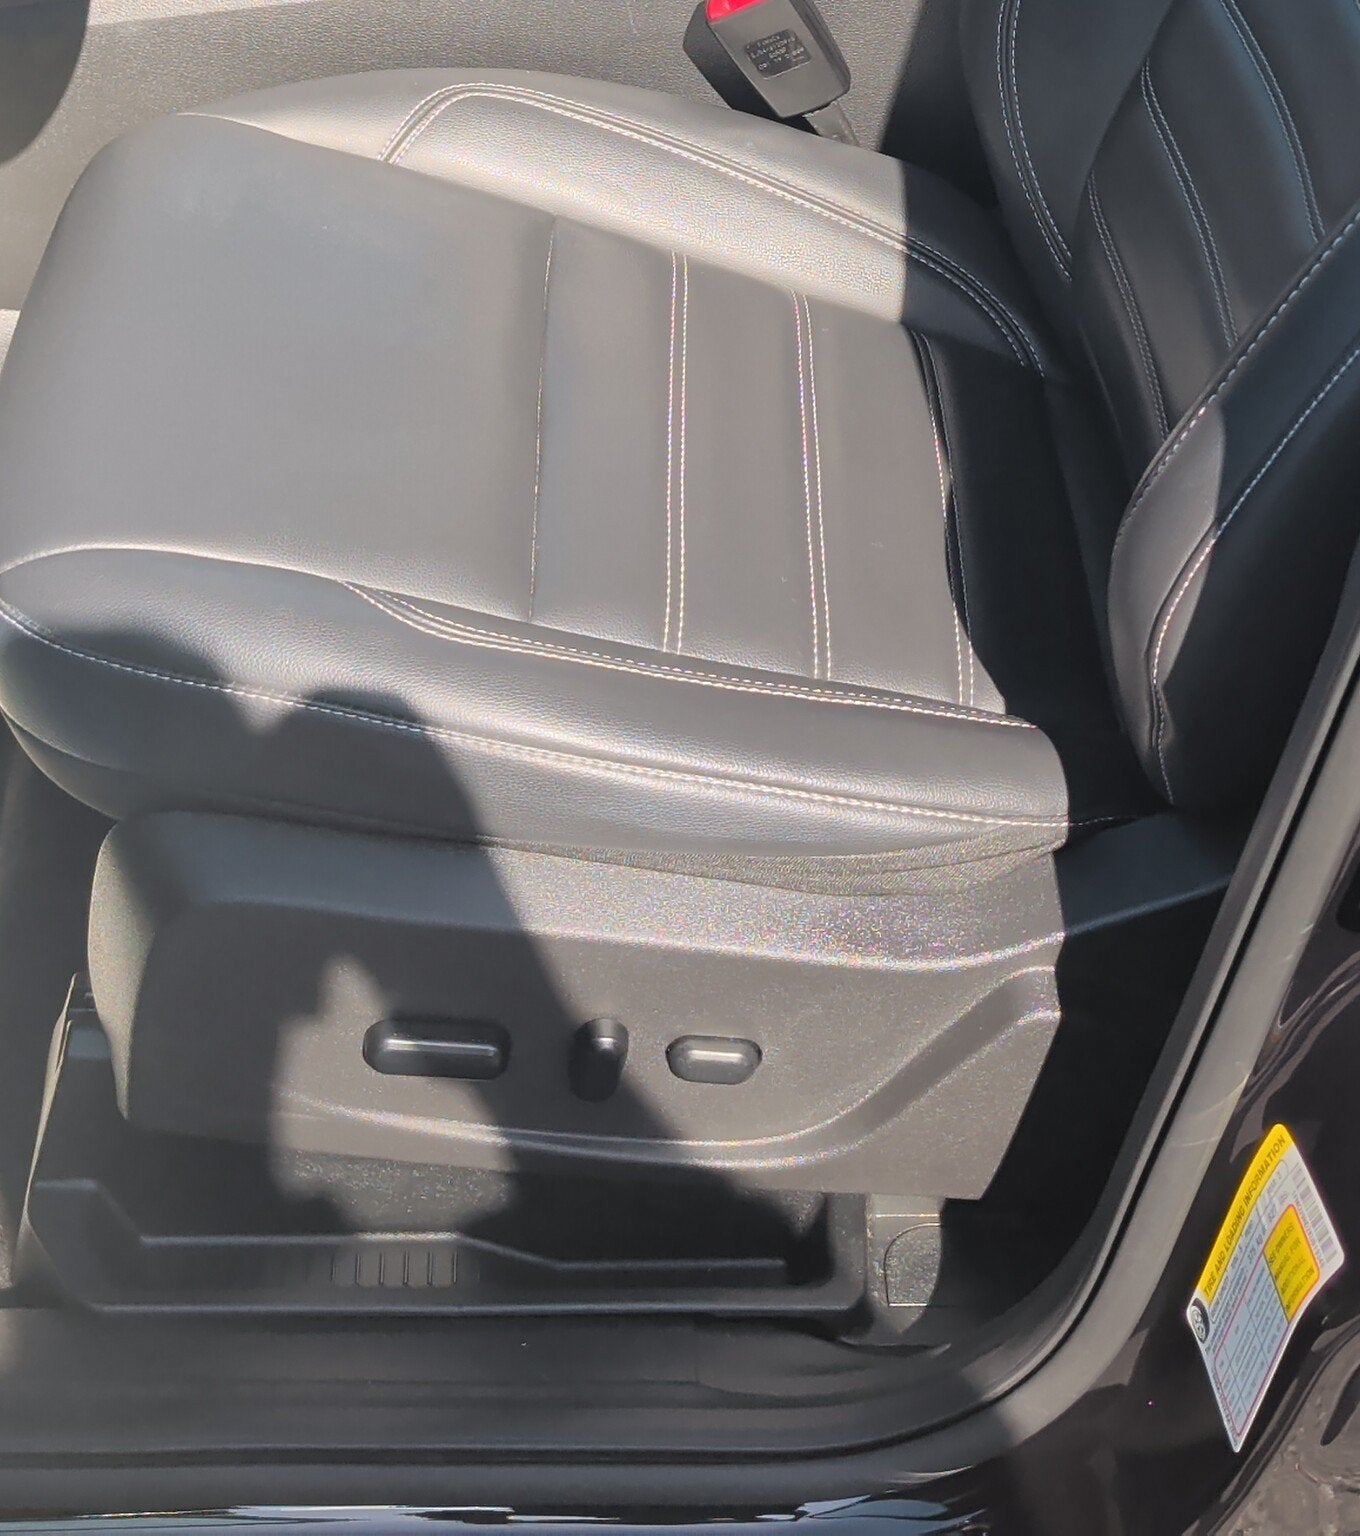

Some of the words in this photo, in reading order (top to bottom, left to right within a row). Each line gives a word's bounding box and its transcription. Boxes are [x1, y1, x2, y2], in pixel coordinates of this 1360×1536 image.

[1204, 1274, 1217, 1297] TIRE
[1215, 1250, 1227, 1273] AND
[1223, 1206, 1246, 1252] LOADING
[1242, 1134, 1286, 1206] INFORMATION
